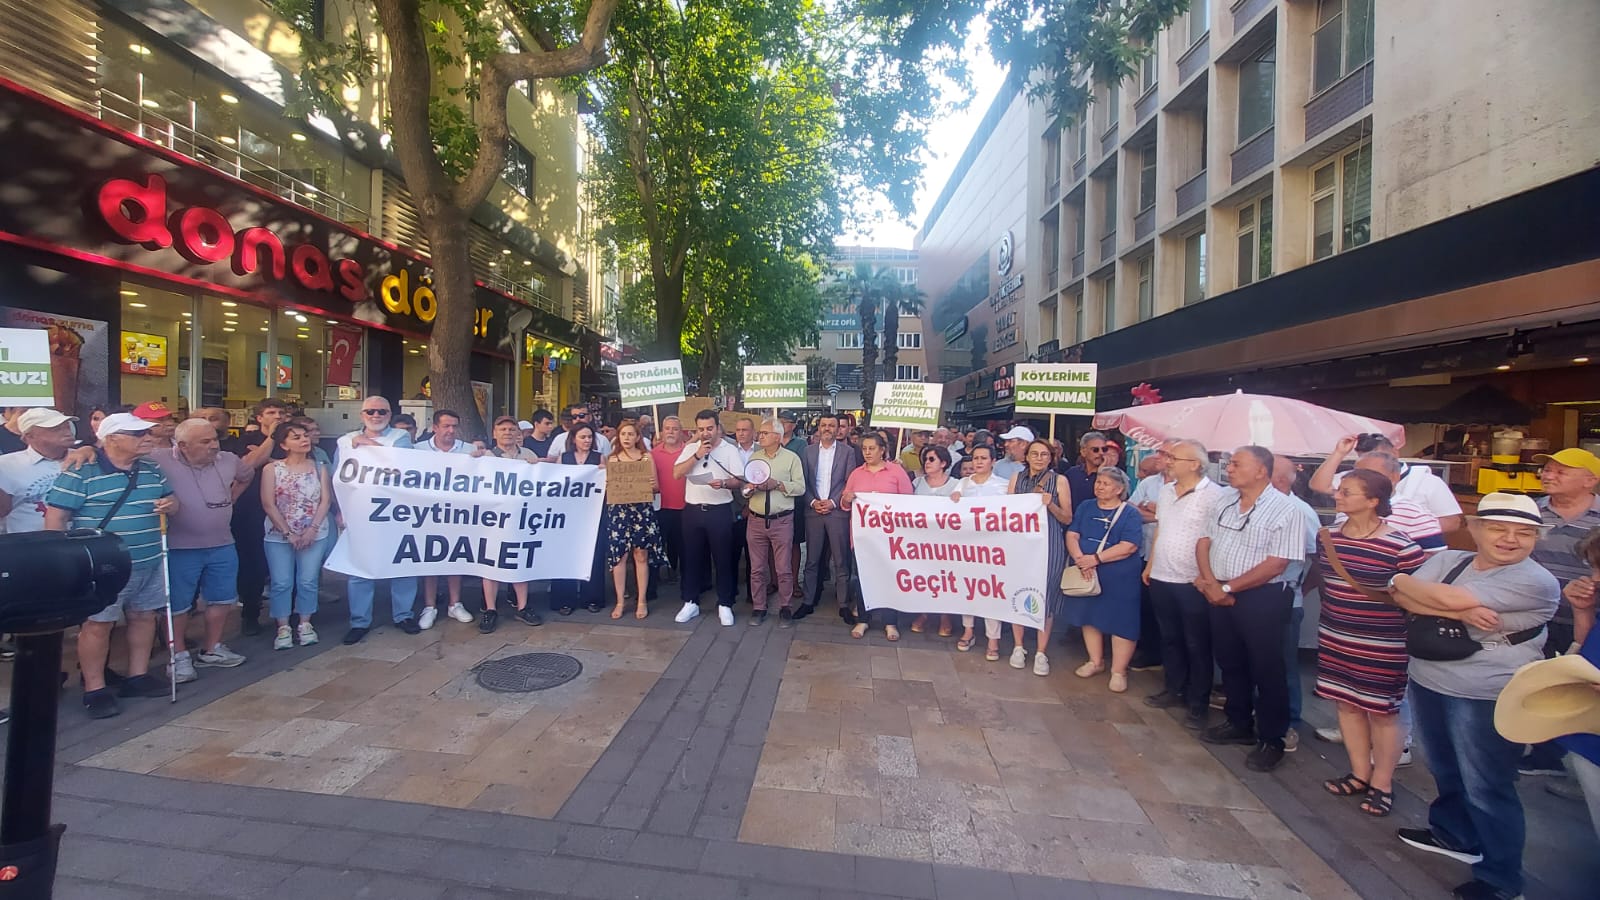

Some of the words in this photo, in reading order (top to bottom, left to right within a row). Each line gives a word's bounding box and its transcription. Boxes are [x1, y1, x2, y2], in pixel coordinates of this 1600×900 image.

[98, 173, 367, 300] donas
[381, 268, 493, 338] dör
[619, 367, 680, 381] TOPRAĞIMA
[745, 370, 805, 381] ZEYTİNİME
[1021, 369, 1090, 382] KÖYLERİME
[621, 383, 681, 398] DOKUNMA!
[745, 386, 804, 398] DOKUNMA!
[1017, 390, 1092, 404] DOKUNMA!
[883, 398, 928, 406] TOPRAĞIMA
[874, 406, 937, 419] DOKUNMA!
[339, 458, 602, 498] Ormanlar-Meralar-
[368, 497, 510, 528] Zeytinler
[518, 502, 566, 535] İçin
[856, 503, 928, 534] Yağma
[935, 512, 962, 531] ve
[970, 506, 1040, 533] Talan
[392, 534, 542, 570] ADALET
[888, 536, 1006, 567] Kanununa
[896, 568, 958, 598] Geçit
[963, 574, 1007, 601] yok
